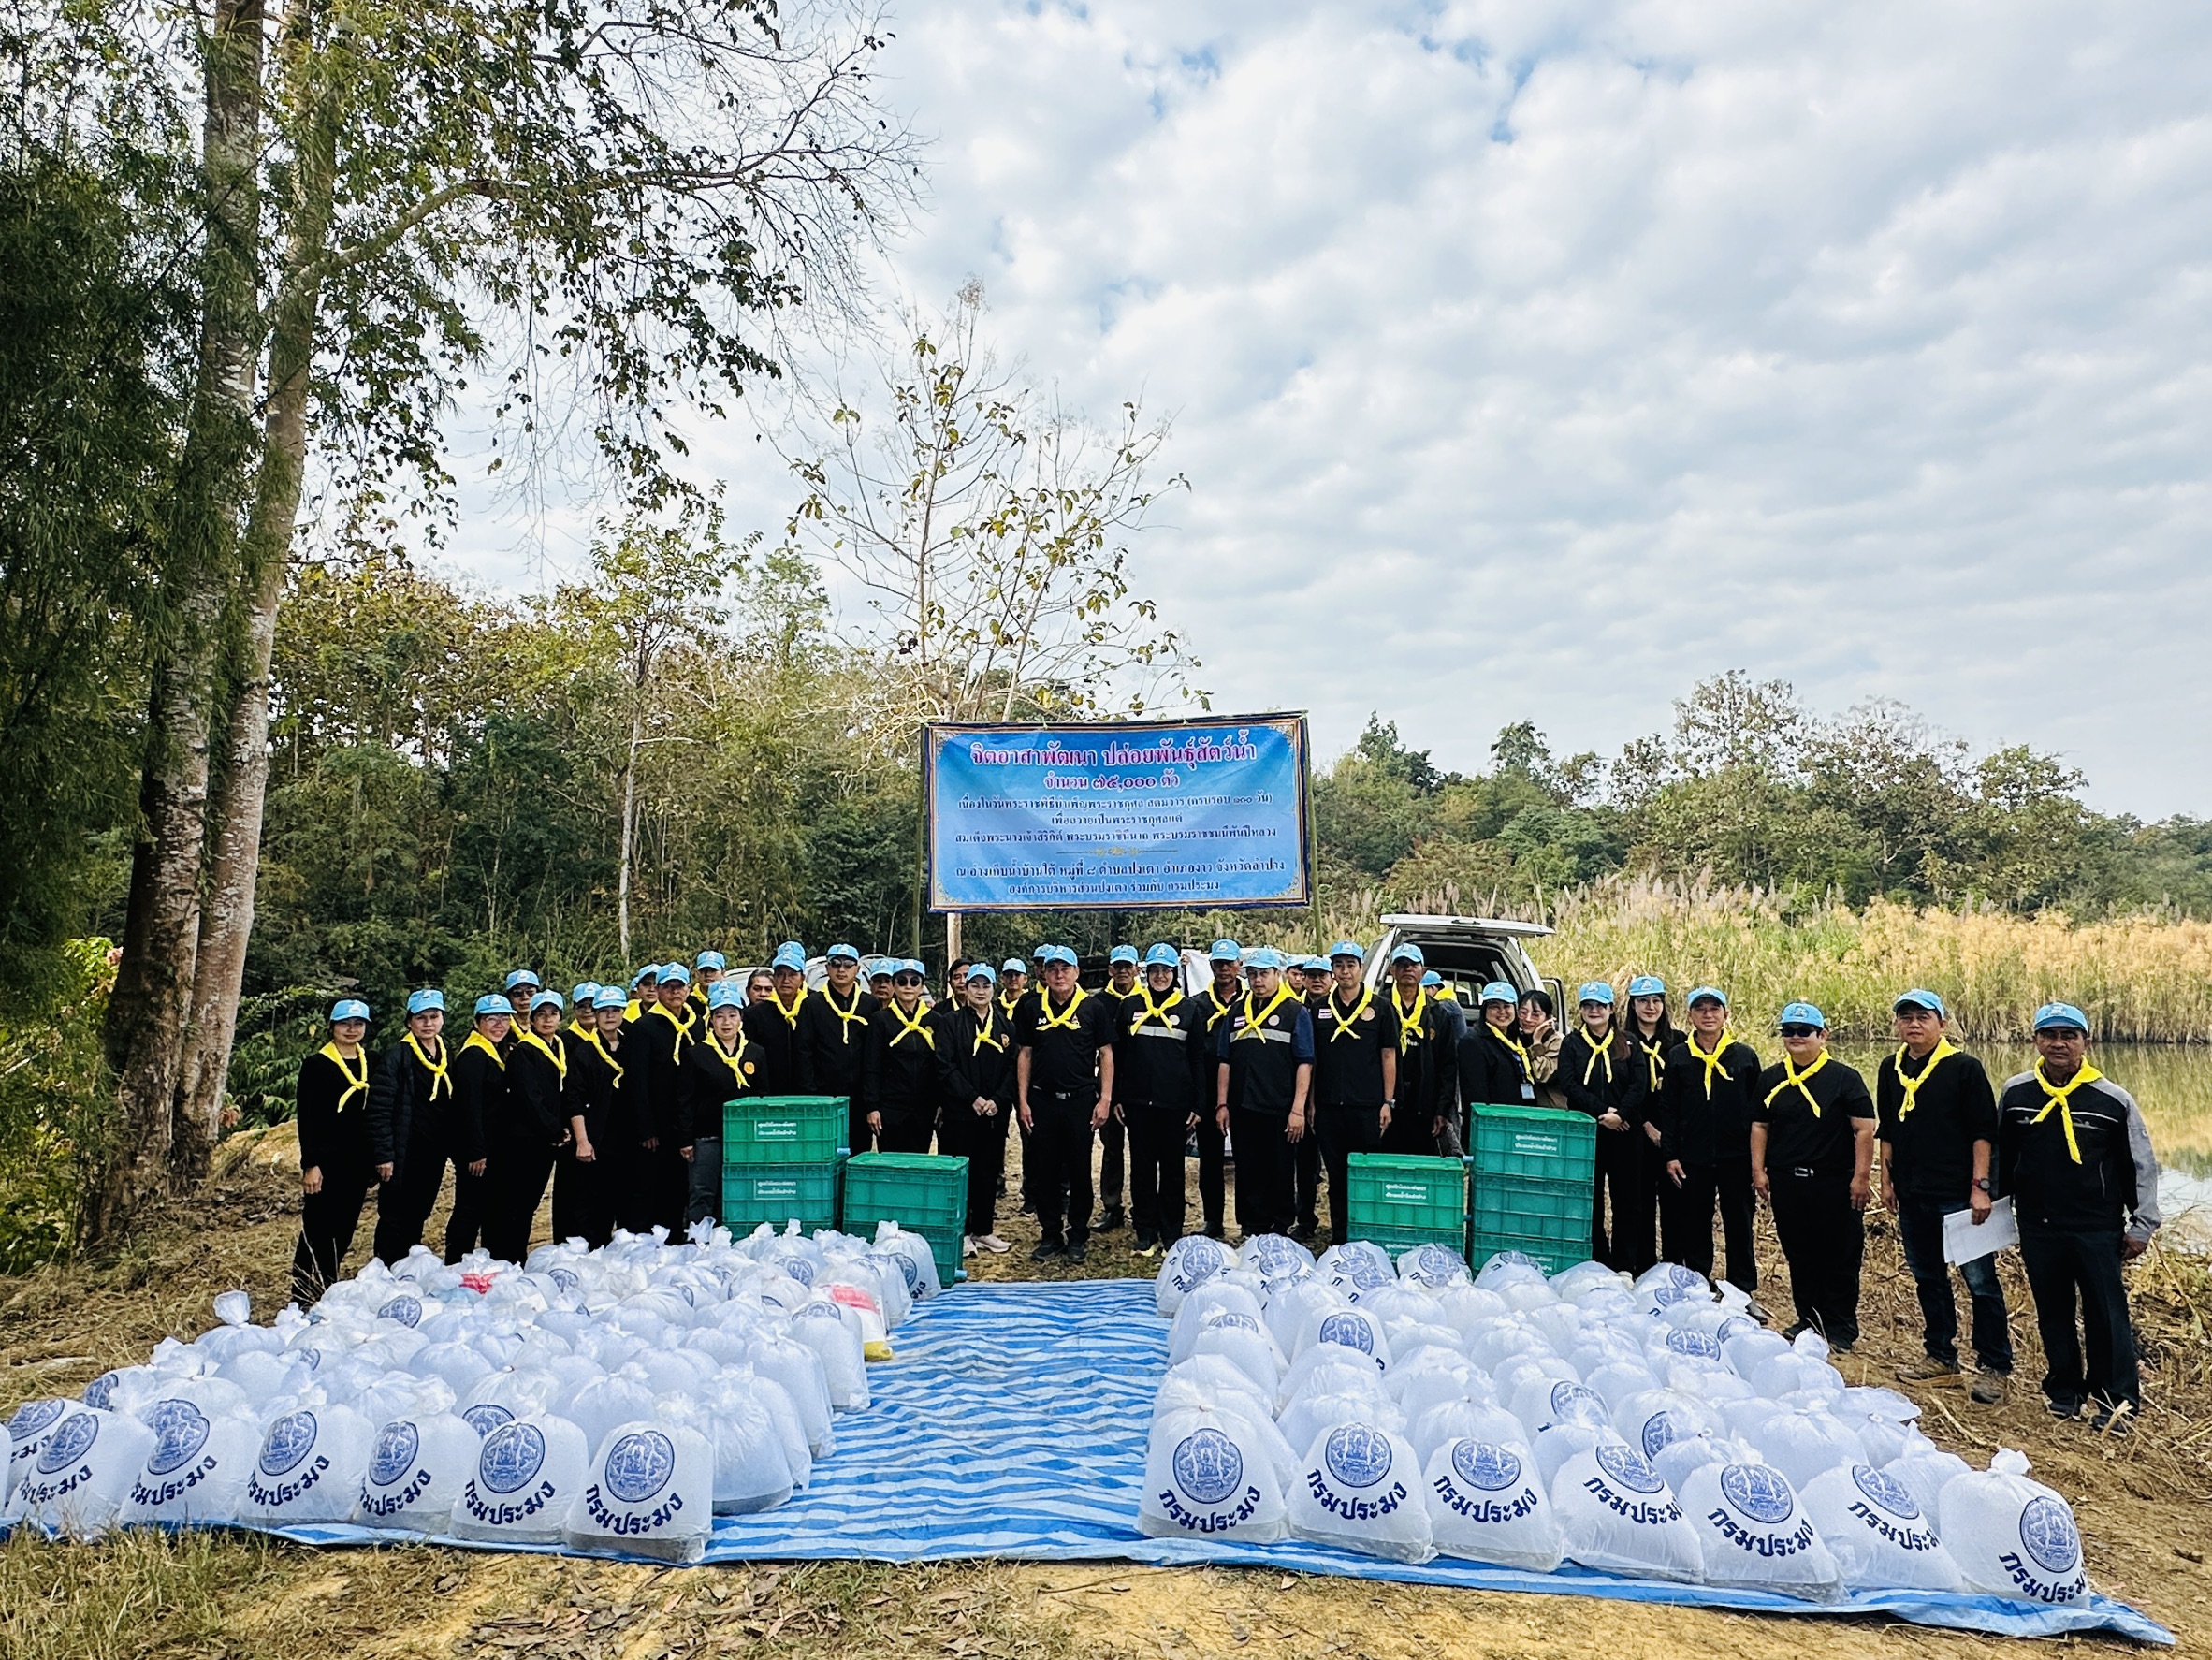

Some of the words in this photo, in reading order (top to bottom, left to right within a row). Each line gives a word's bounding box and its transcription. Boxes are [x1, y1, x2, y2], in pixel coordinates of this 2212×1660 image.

[970, 740, 1097, 766] จิตอาสาพัฒนา
[1102, 729, 1257, 771] ปล่อยพันธุ์สัตว์น้ำ
[1044, 770, 1089, 790] จำนวน
[1092, 775, 1156, 791] ๗๕,๐๐๐
[1159, 768, 1180, 788] ตัว
[955, 866, 967, 878] ณ
[1059, 859, 1084, 881] หมู่ที่
[1086, 866, 1097, 876] ๘
[1215, 856, 1286, 873] จังหวัดลำปาง
[1167, 878, 1220, 892] กรมประมง
[464, 1478, 556, 1525] กรมประมง
[586, 1483, 684, 1535] กรมประมง
[1159, 1485, 1261, 1533] กรมประมง
[1307, 1468, 1407, 1520] กรมประมง
[1433, 1475, 1537, 1523] กรมประมง
[1707, 1507, 1814, 1557] กรมประมง
[1847, 1501, 1941, 1551] กรมประม
